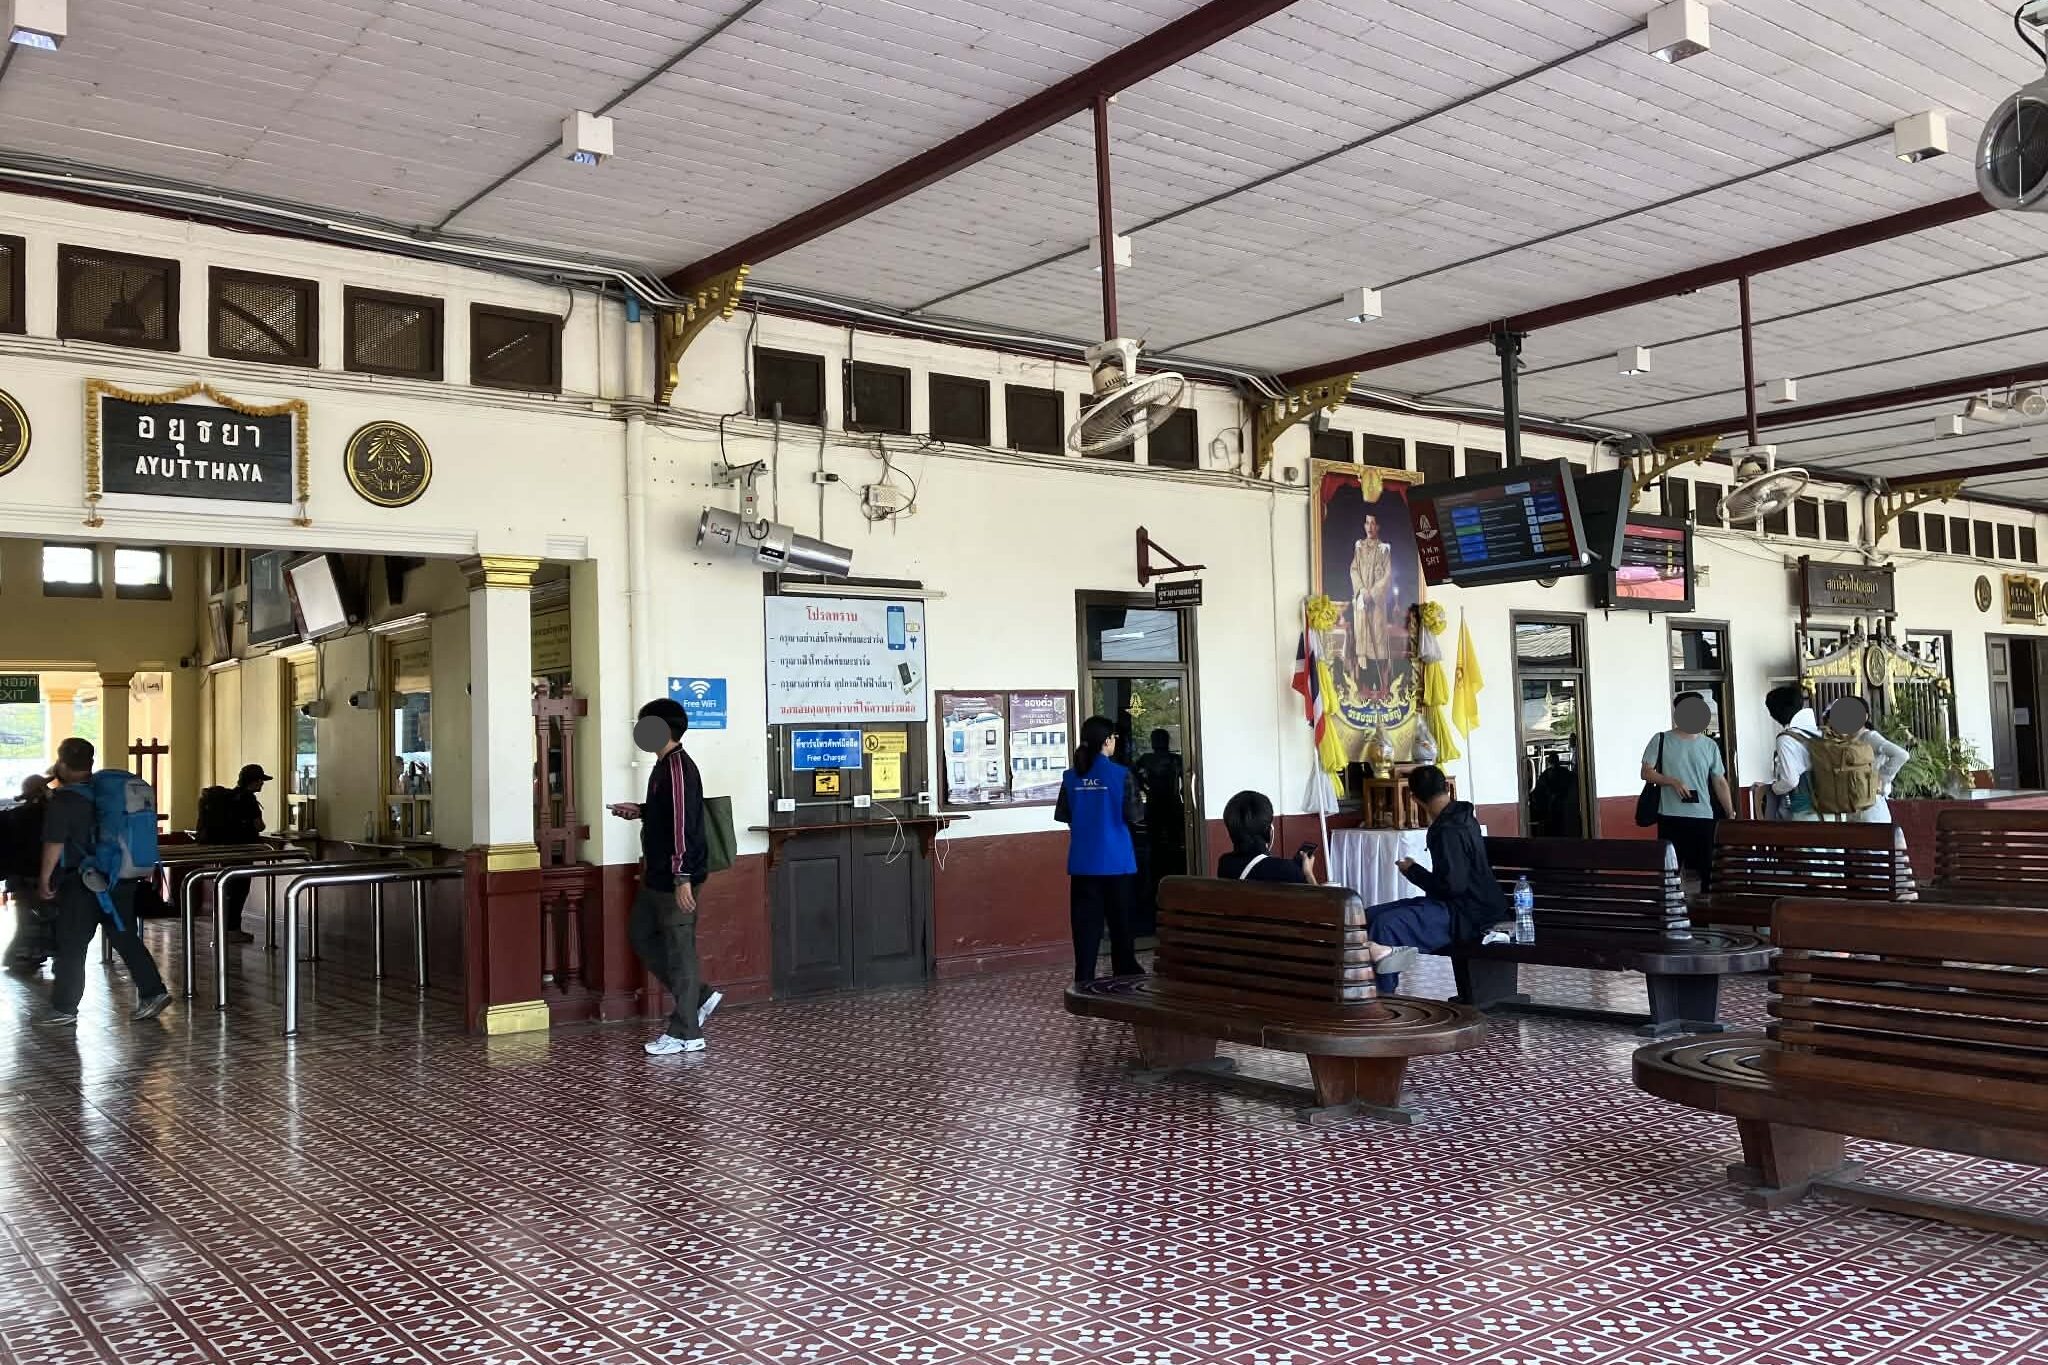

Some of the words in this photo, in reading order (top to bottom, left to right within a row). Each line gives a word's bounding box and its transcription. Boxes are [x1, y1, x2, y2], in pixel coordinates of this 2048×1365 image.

[138, 415, 260, 457] อยุธยา
[135, 455, 263, 482] AYUTTHAYA
[1425, 555, 1441, 566] SRT
[805, 605, 858, 622] โปรดทราบ
[683, 699, 700, 708] Free
[807, 754, 822, 762] Free
[822, 753, 848, 763] Charger
[1082, 778, 1101, 786] TAC
